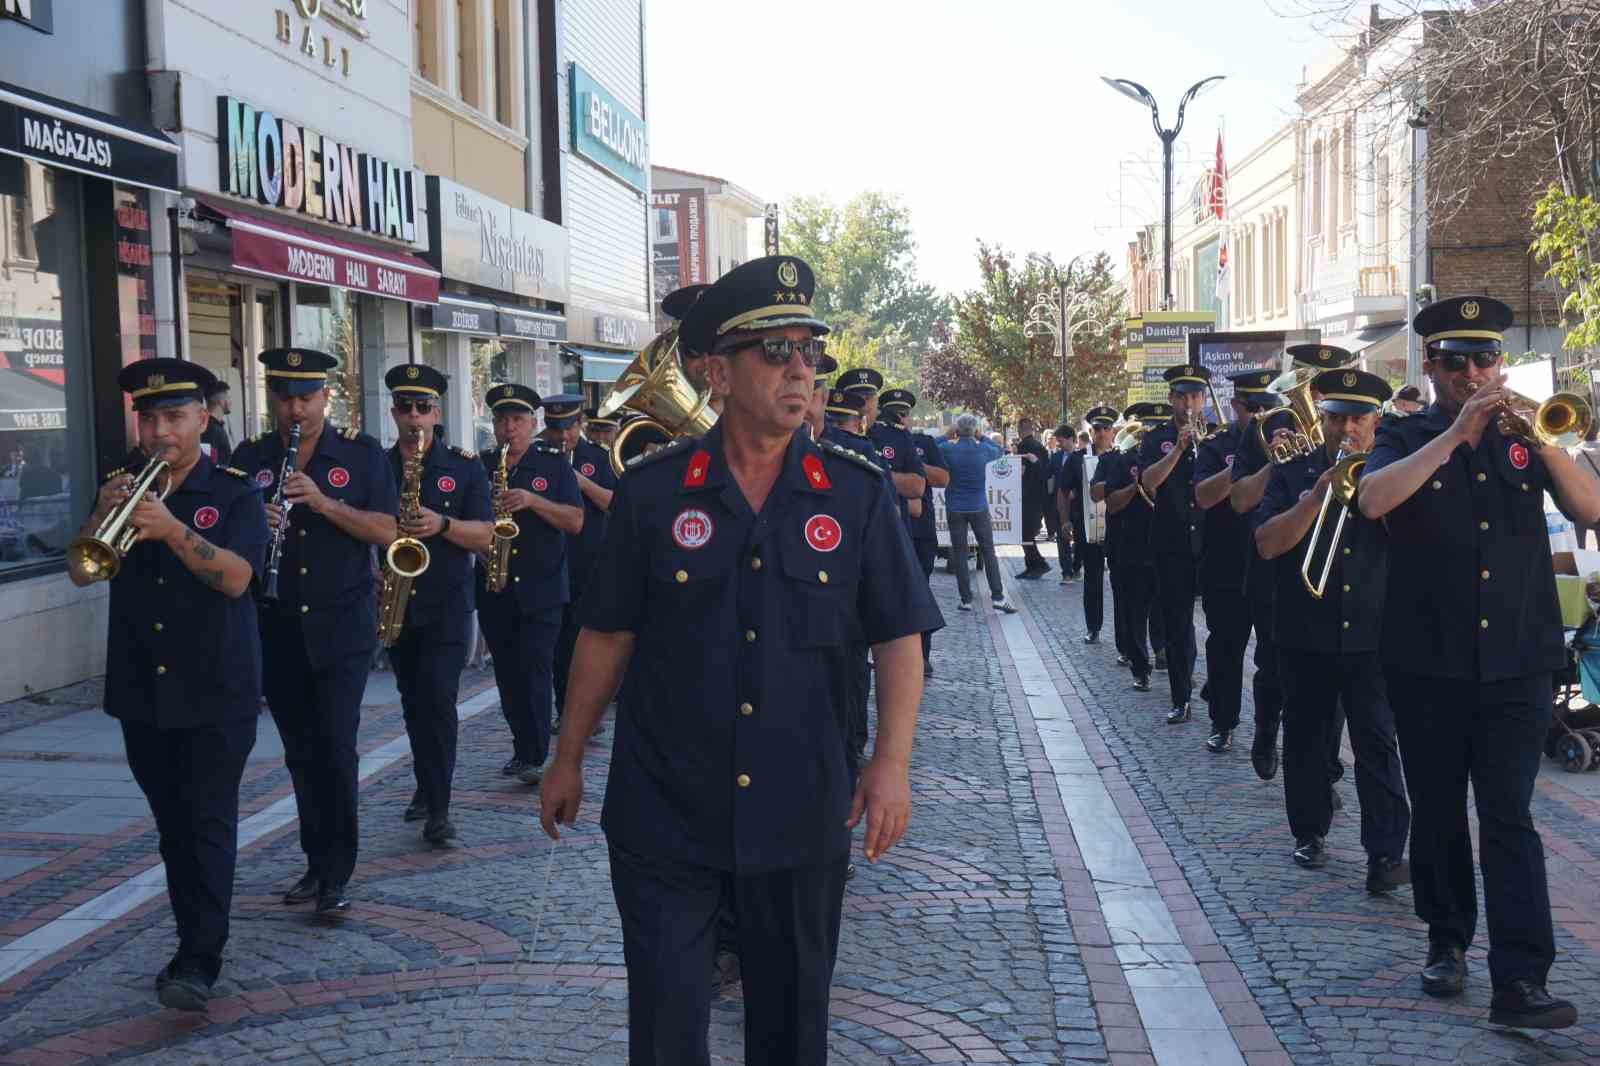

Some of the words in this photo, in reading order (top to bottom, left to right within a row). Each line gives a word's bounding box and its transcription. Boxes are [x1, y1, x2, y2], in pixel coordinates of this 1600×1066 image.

[23, 117, 112, 168] MAĞAZASI
[218, 96, 363, 228] MODERN
[363, 153, 418, 243] HALI
[287, 246, 335, 282] MODERN
[346, 260, 368, 288] HALI
[377, 267, 407, 297] SARAYI
[1145, 326, 1180, 337] Daniel
